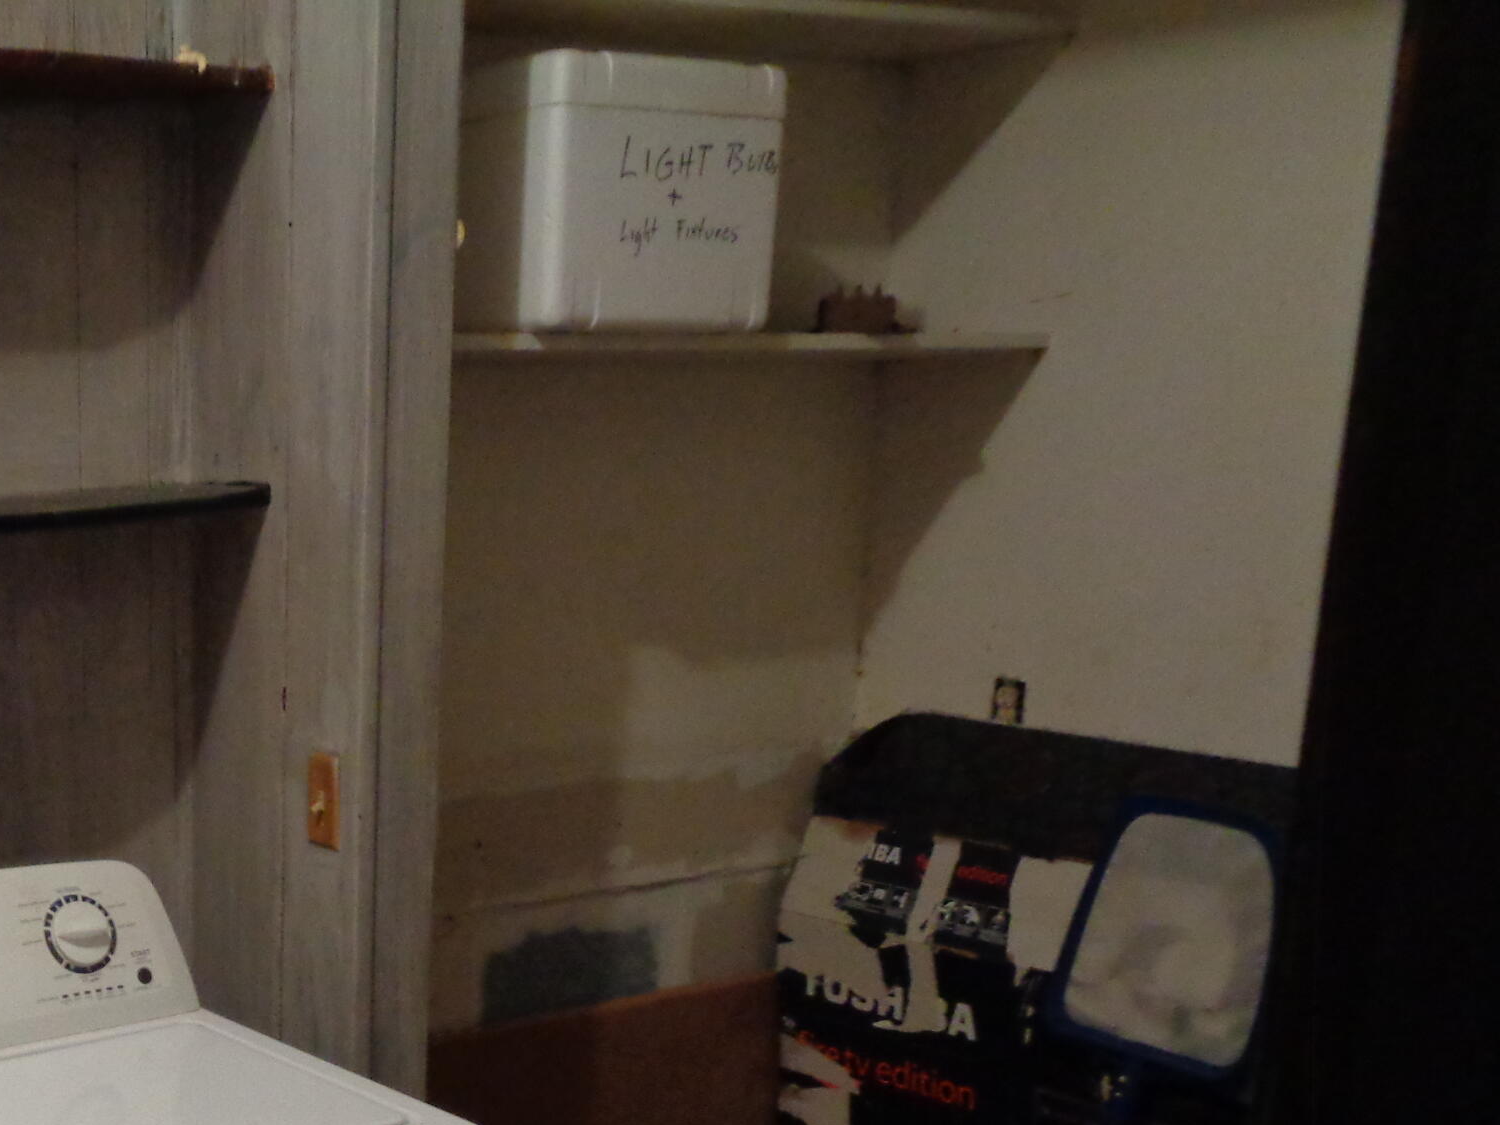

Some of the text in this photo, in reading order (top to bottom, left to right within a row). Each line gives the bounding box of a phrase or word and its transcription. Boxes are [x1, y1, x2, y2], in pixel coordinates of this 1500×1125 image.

[620, 135, 713, 181] LIGHT
[620, 217, 738, 256] Light Fixtures
[873, 1058, 977, 1112] edition
